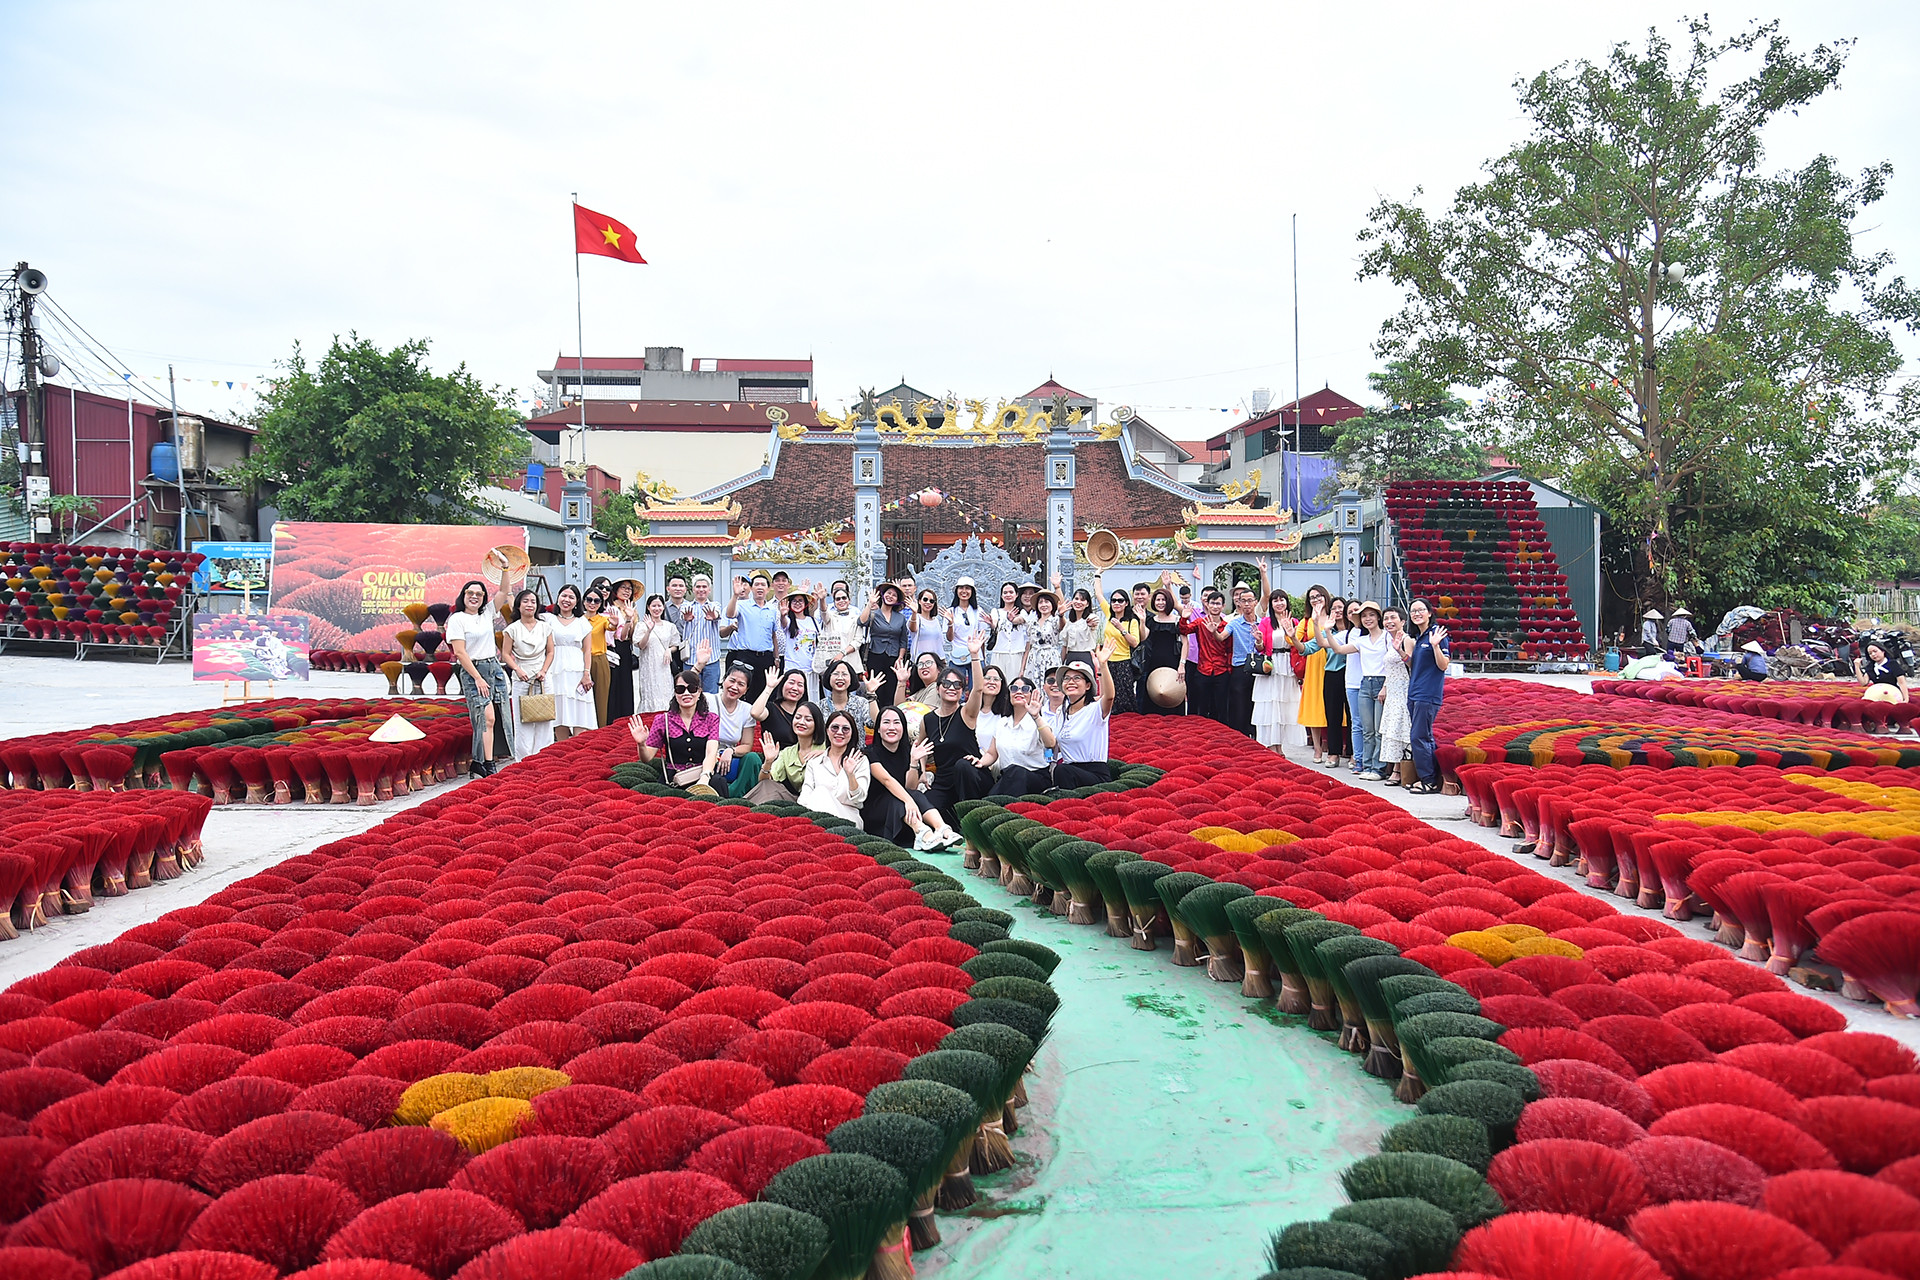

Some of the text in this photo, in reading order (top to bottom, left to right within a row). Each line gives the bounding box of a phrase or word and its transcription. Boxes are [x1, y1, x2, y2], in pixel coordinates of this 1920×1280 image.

[362, 569, 426, 587] QUẢNG
[362, 585, 425, 600] PHÚ CẦU
[361, 607, 376, 615] LIFE
[377, 607, 394, 615] AND
